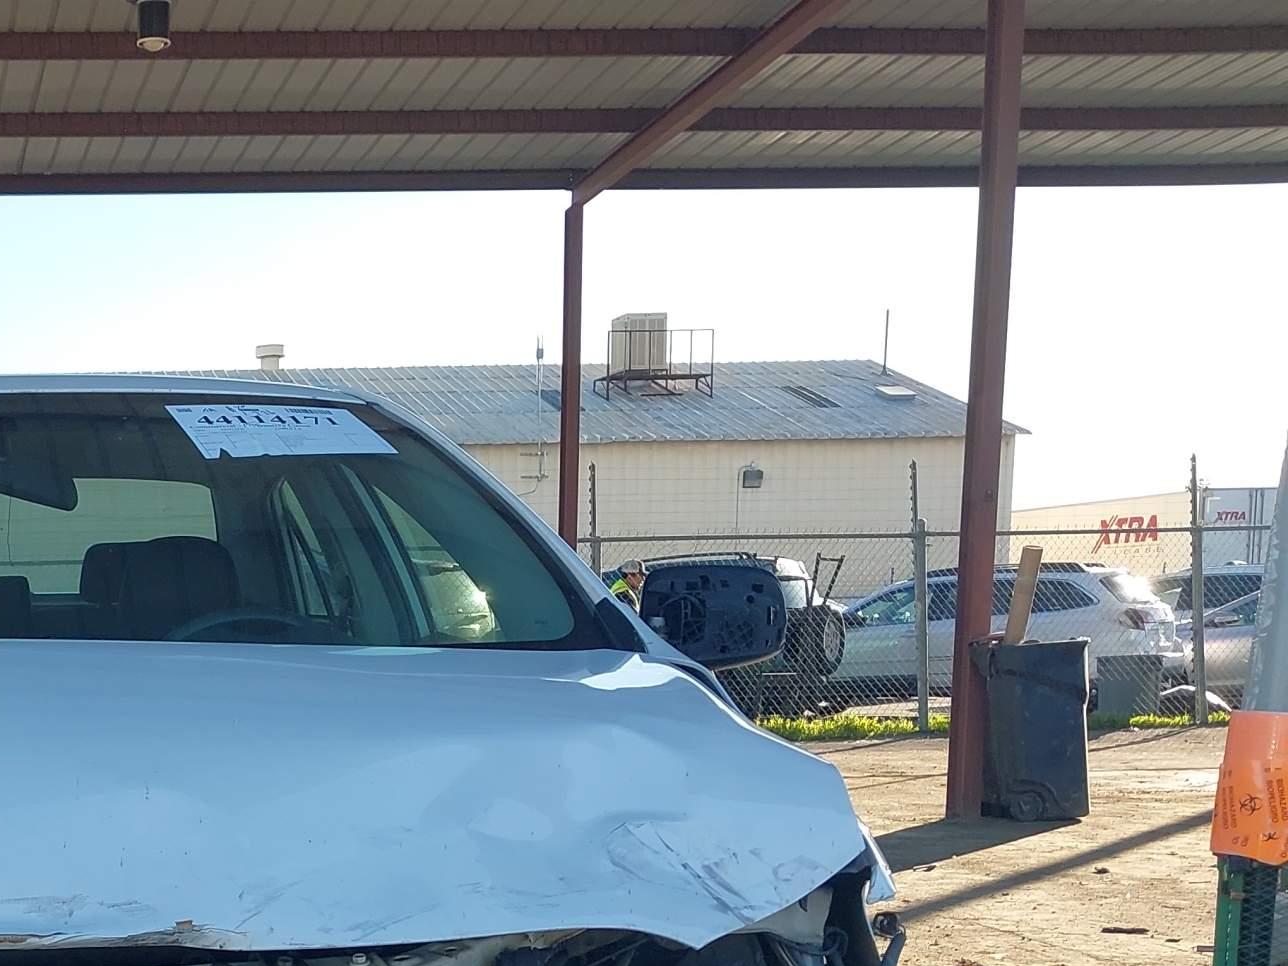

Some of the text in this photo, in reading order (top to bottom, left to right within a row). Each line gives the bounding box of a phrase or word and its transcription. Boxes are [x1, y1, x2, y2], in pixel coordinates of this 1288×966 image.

[197, 415, 339, 425] 44114171
[1214, 510, 1246, 523] XTRA
[1091, 514, 1159, 555] XTRA
